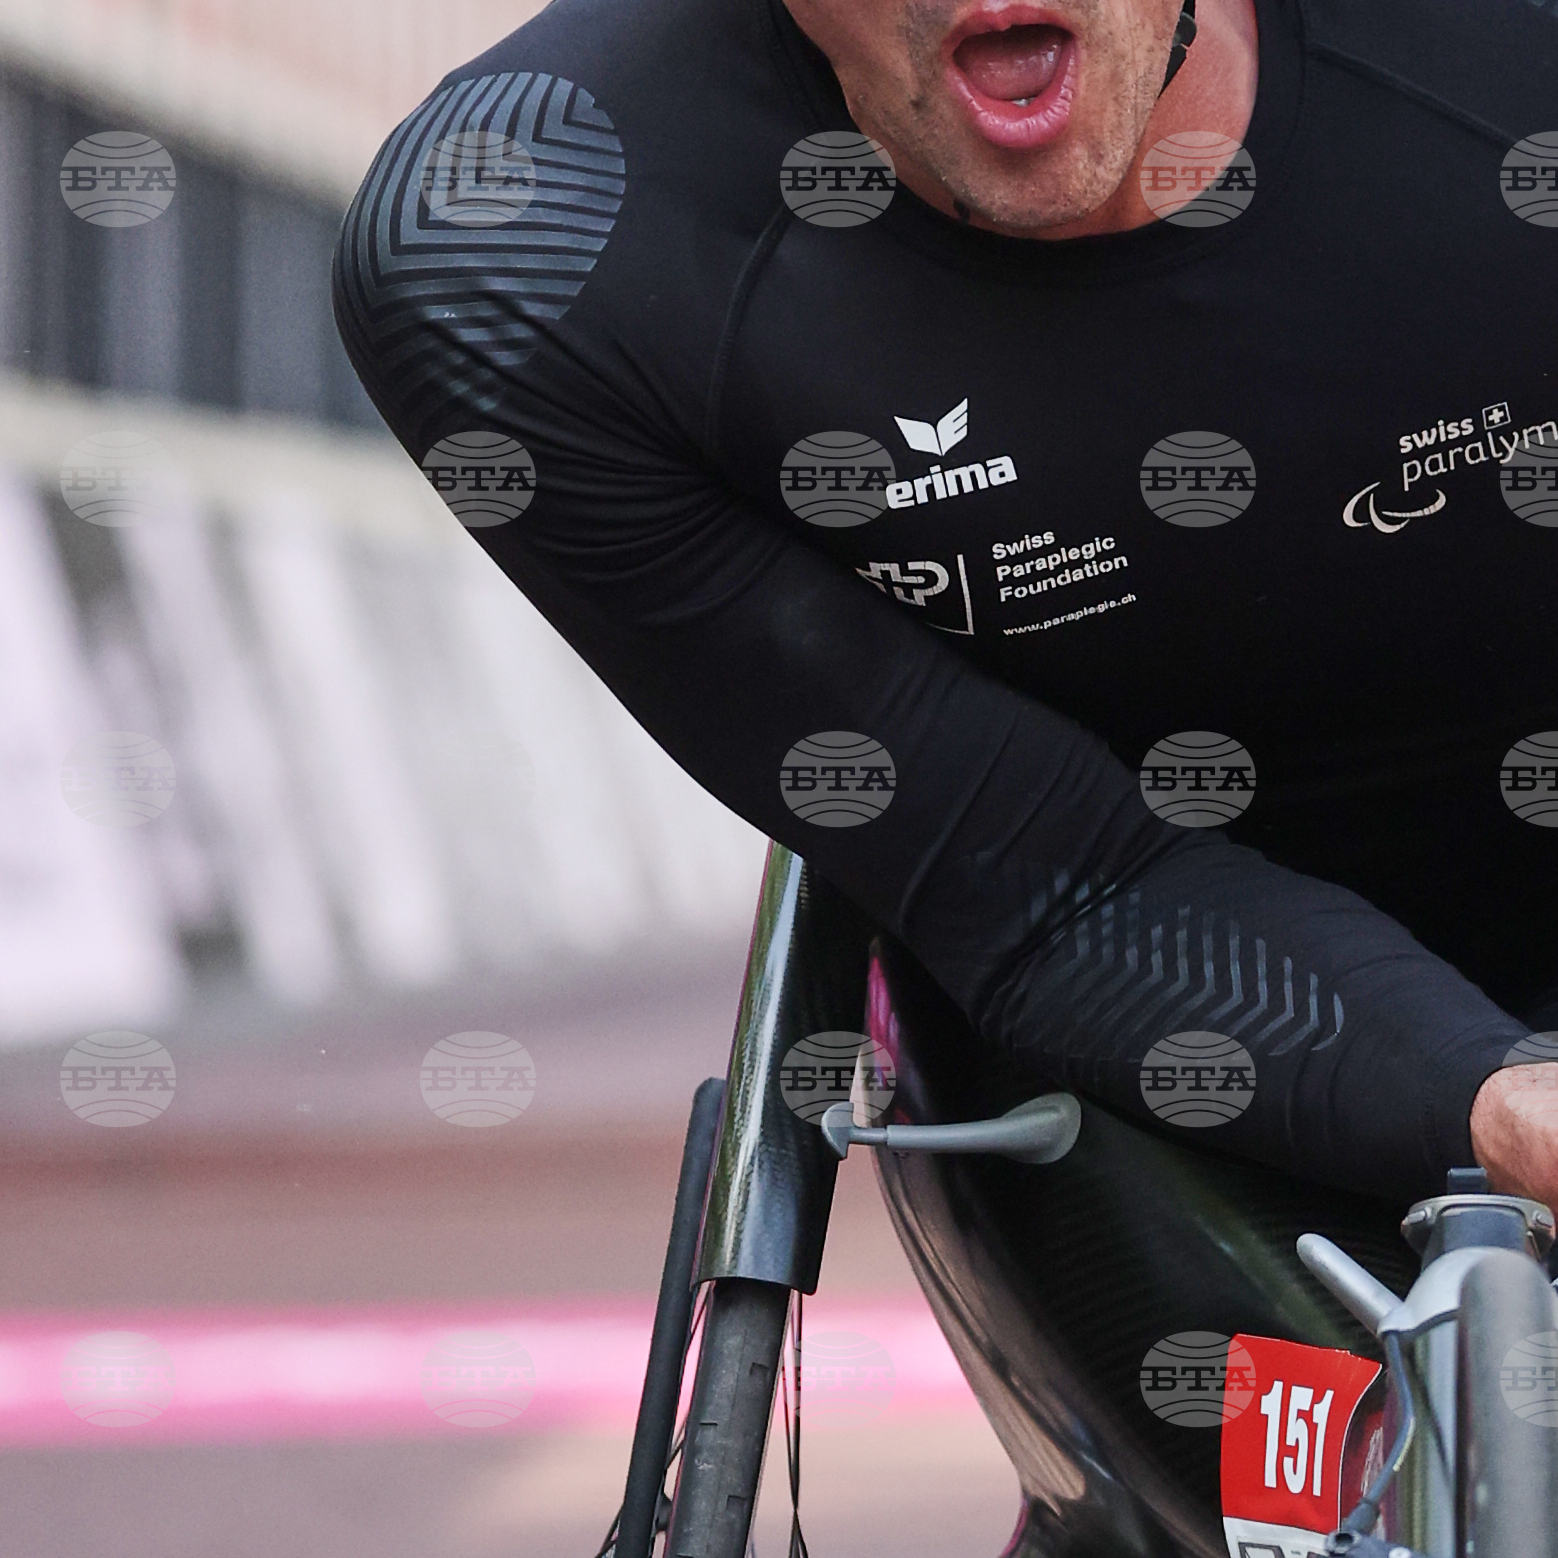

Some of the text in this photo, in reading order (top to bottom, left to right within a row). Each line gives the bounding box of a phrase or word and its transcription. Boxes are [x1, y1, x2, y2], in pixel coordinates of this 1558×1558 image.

[1398, 415, 1475, 454] swiss
[885, 455, 1018, 510] erima
[992, 531, 1055, 559] Swiss
[997, 537, 1115, 582] Paraplegic
[999, 555, 1128, 602] Foundation
[1260, 1379, 1335, 1498] 151
